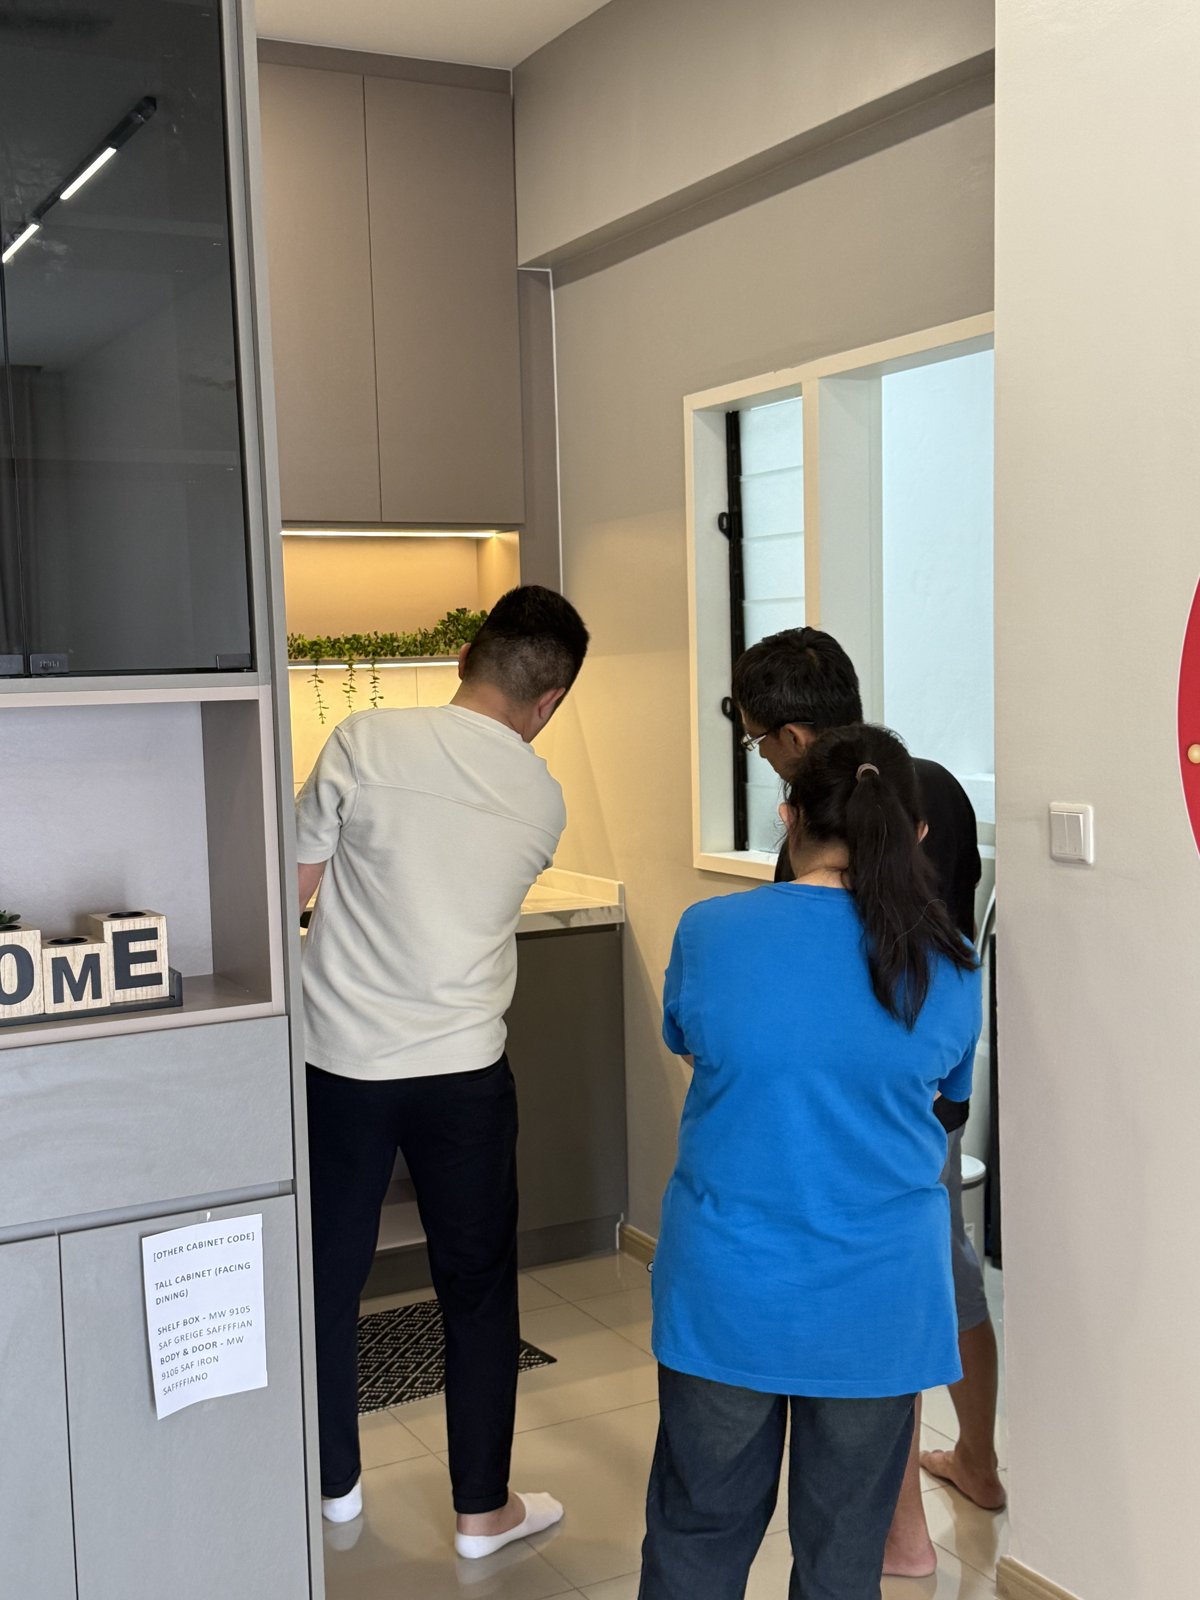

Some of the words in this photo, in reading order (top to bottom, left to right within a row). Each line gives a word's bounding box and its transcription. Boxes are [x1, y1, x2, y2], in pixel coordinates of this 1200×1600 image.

[153, 1245, 184, 1263] [OTHER
[186, 1237, 225, 1252] CABINET
[227, 1231, 255, 1244] CODE]
[155, 1279, 173, 1291] TALL
[175, 1269, 212, 1285] CABINET
[214, 1261, 251, 1277] (FACING
[155, 1288, 189, 1306] DINING)
[157, 1321, 181, 1336] SHELF
[182, 1315, 201, 1327] BOX
[208, 1310, 227, 1321] MW
[228, 1305, 251, 1317] 9105
[158, 1338, 172, 1351] SAF
[173, 1328, 204, 1345] GREIGE
[160, 1351, 181, 1366] BODY
[182, 1348, 189, 1357] &
[191, 1341, 218, 1355] DOOR
[226, 1335, 245, 1347] MW
[161, 1367, 180, 1381] 9106
[180, 1361, 195, 1373] SAF
[197, 1355, 219, 1367] IRON
